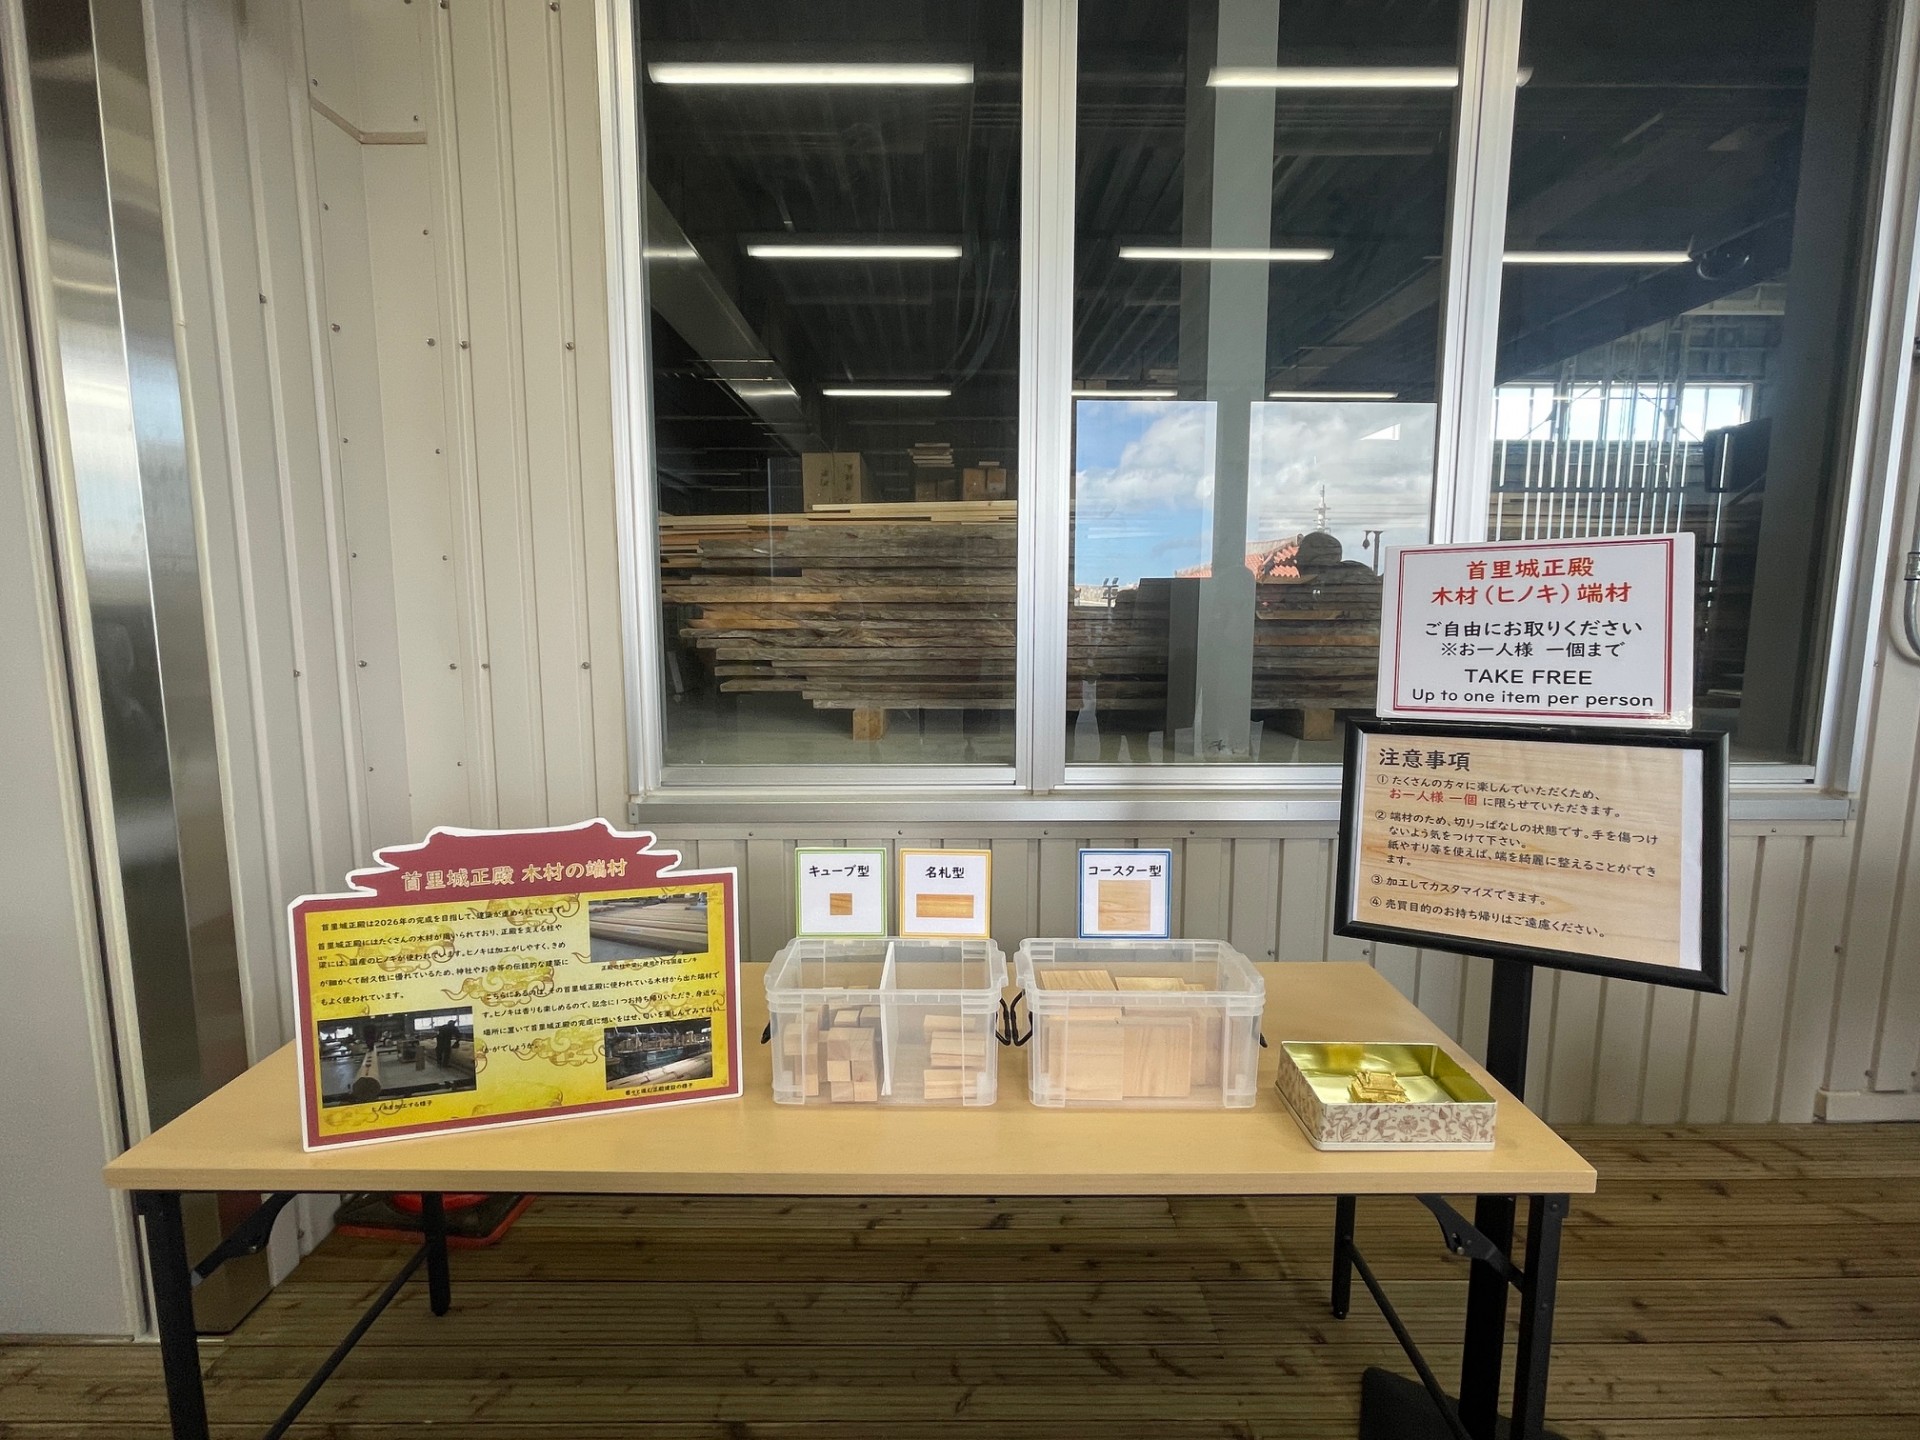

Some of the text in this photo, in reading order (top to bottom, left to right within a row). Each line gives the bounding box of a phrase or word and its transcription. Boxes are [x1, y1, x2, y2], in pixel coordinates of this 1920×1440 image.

[1466, 556, 1595, 581] 首里城正殿
[1425, 620, 1643, 638] ご自由にお取りください
[1441, 641, 1625, 658] ※お一人様 一個まで
[1465, 669, 1593, 685] TAKE FREE
[1412, 688, 1654, 709] Up to one item per person
[1378, 748, 1471, 772] 注意事項
[1392, 775, 1601, 801] たくさんの方々に楽しんでいただくため、
[1389, 788, 1621, 818] お一人様 一個 に限らせていただきます。
[1389, 826, 1528, 849] ないよう気をつけて下さい。
[1390, 811, 1659, 845] 端材のため、切りっぱなしの状態です。手を傷つけ
[1386, 854, 1413, 867] ます。
[1388, 839, 1657, 878] 紙やすり等を使えば、端を綺麗に整えることができ
[401, 858, 628, 892] 首里城正殿 木材の端材
[808, 864, 870, 878] キューブ型
[925, 865, 965, 880] 名札型
[1088, 864, 1162, 878] コースター型
[1386, 876, 1547, 906] 加工してカスタマイズできます。
[1385, 898, 1606, 938] 売買目的のお持ち帰りはご遠慮ください。
[321, 992, 404, 1006] もよく使われています。
